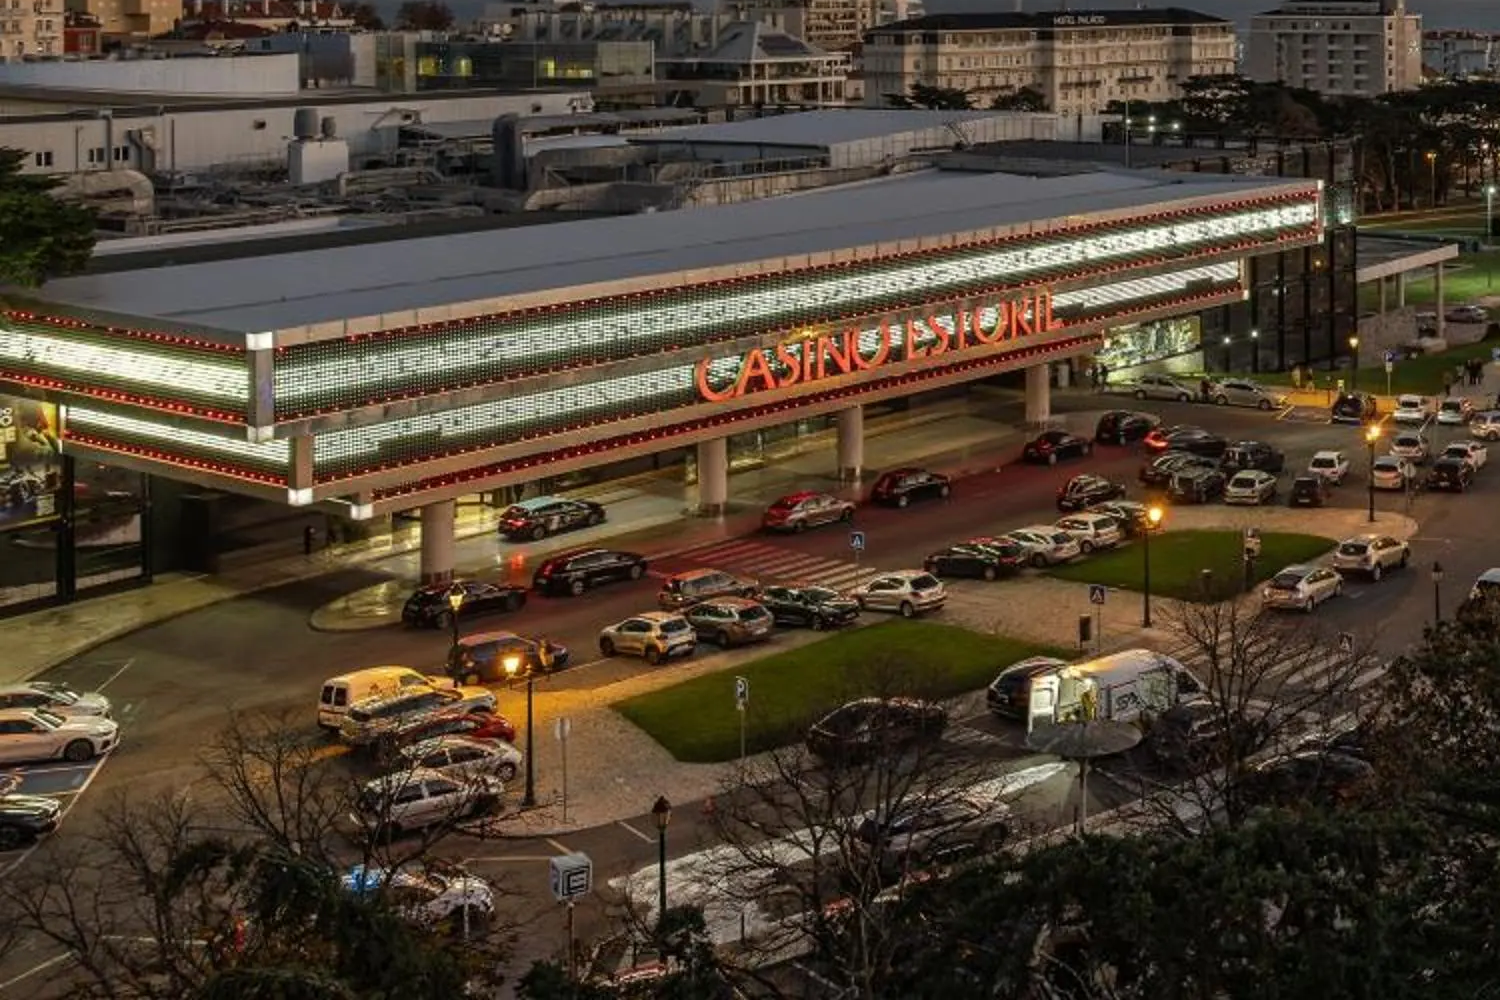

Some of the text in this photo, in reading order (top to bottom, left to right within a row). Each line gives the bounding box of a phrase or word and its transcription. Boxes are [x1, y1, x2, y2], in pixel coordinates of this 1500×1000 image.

[696, 290, 1064, 402] CASINO ESTORIL
[736, 679, 745, 697] P
